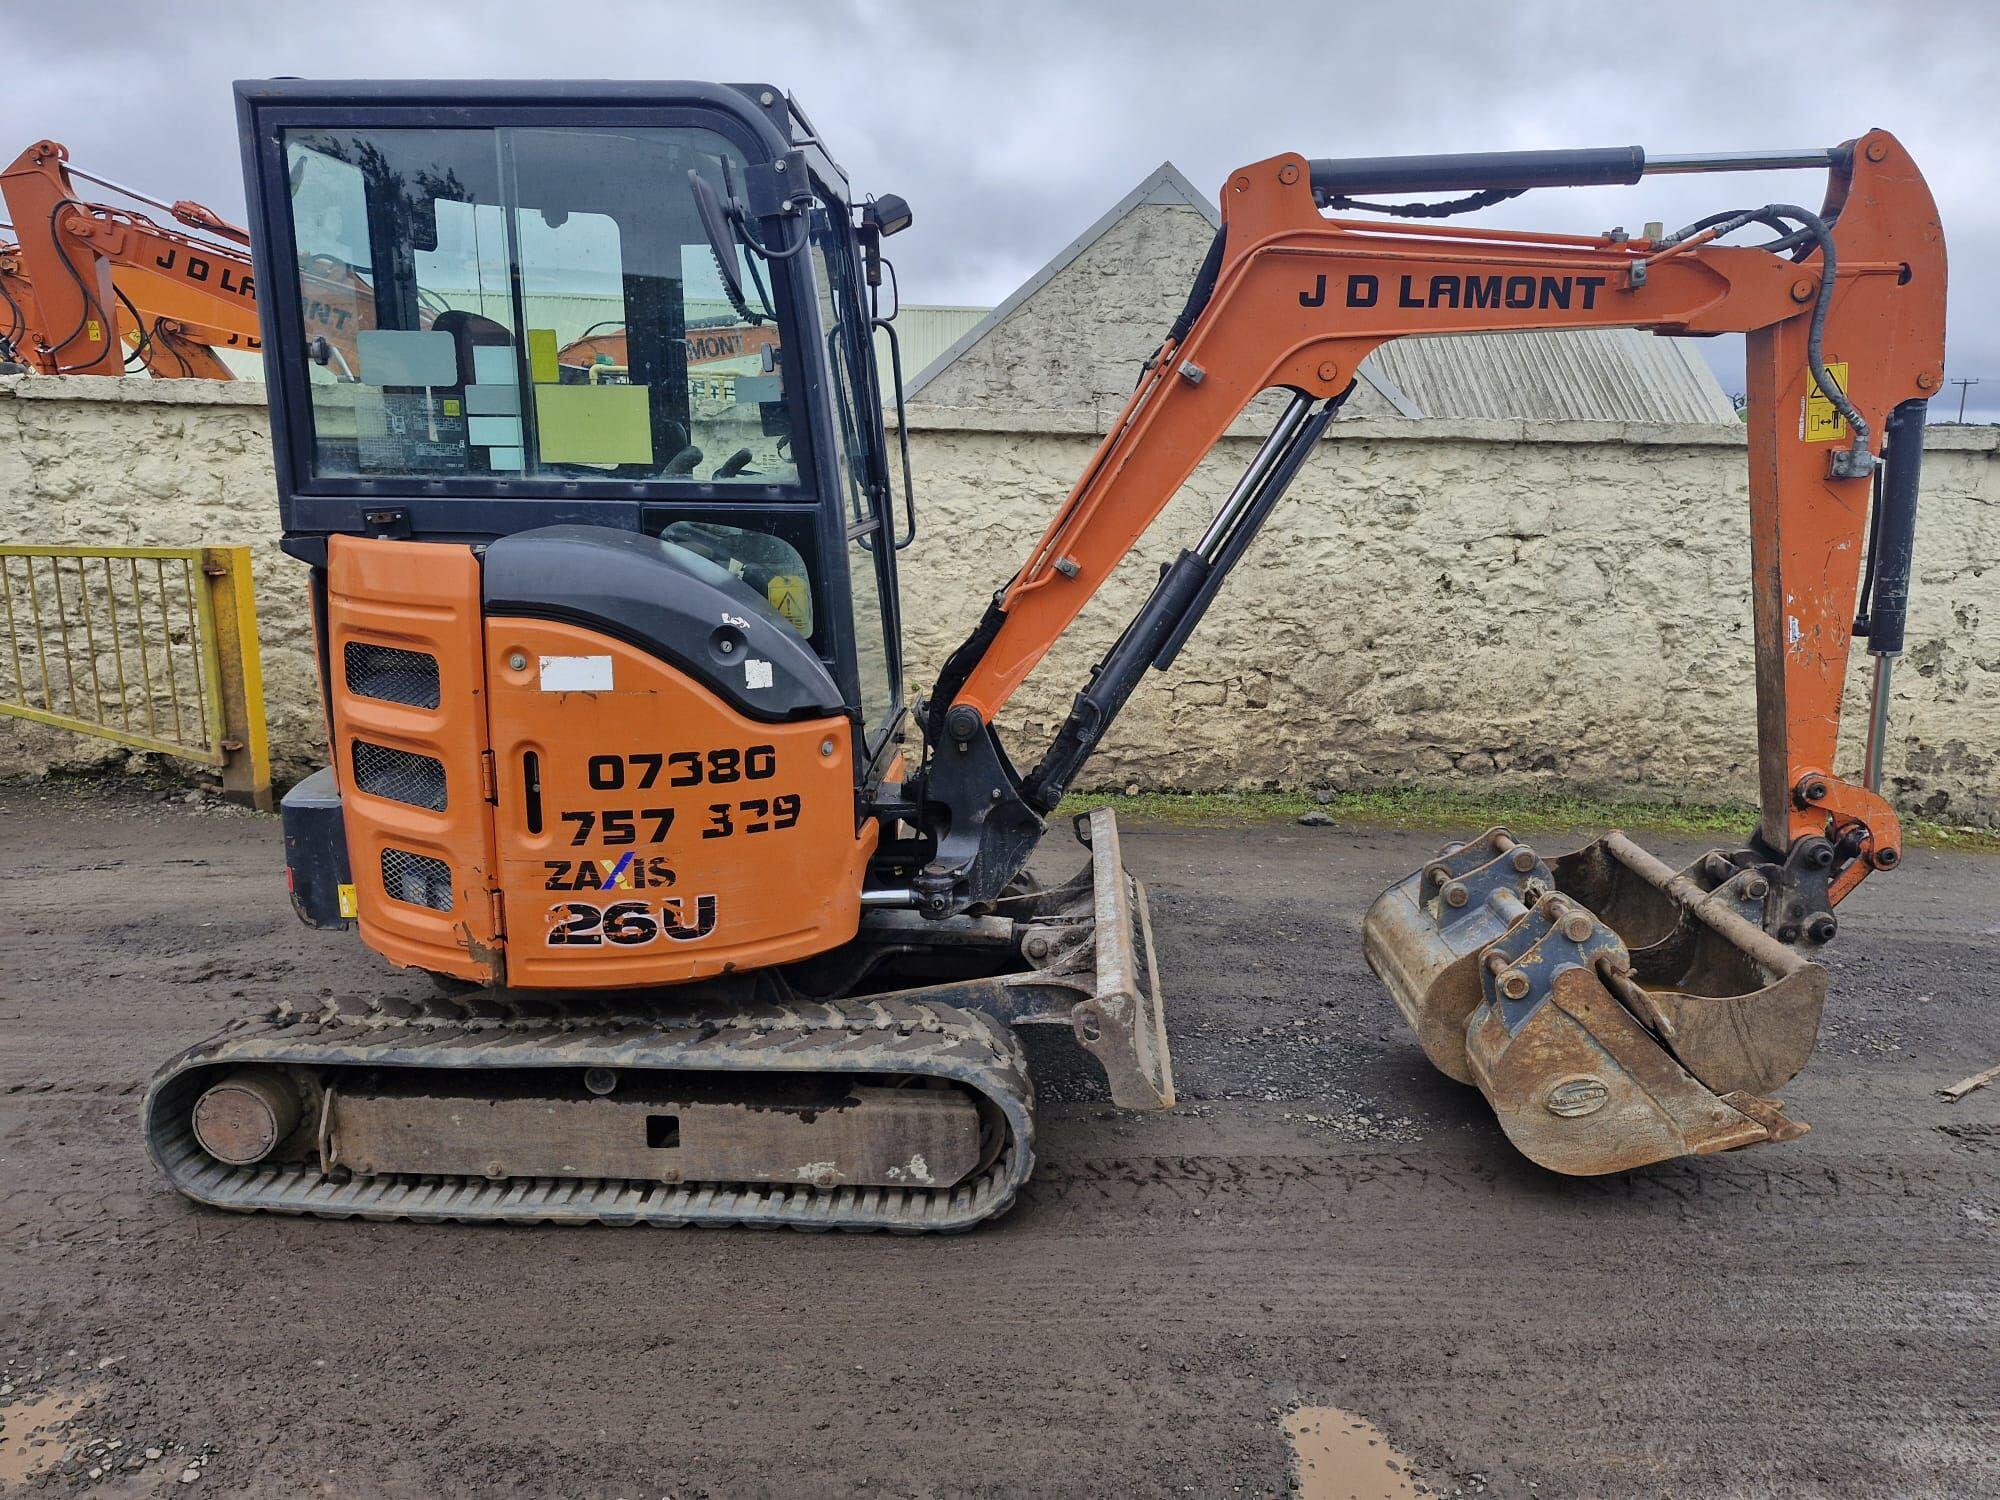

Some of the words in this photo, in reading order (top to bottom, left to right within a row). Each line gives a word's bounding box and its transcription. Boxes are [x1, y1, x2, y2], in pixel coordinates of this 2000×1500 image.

[156, 249, 176, 269] J
[187, 257, 210, 281] D
[1299, 275, 1326, 307] J
[1346, 275, 1379, 307] D
[1399, 275, 1606, 309] LAMONT
[589, 745, 776, 790] 07380
[561, 808, 675, 846] 757
[544, 852, 677, 891] ZAXIS
[546, 895, 717, 946] 26U
